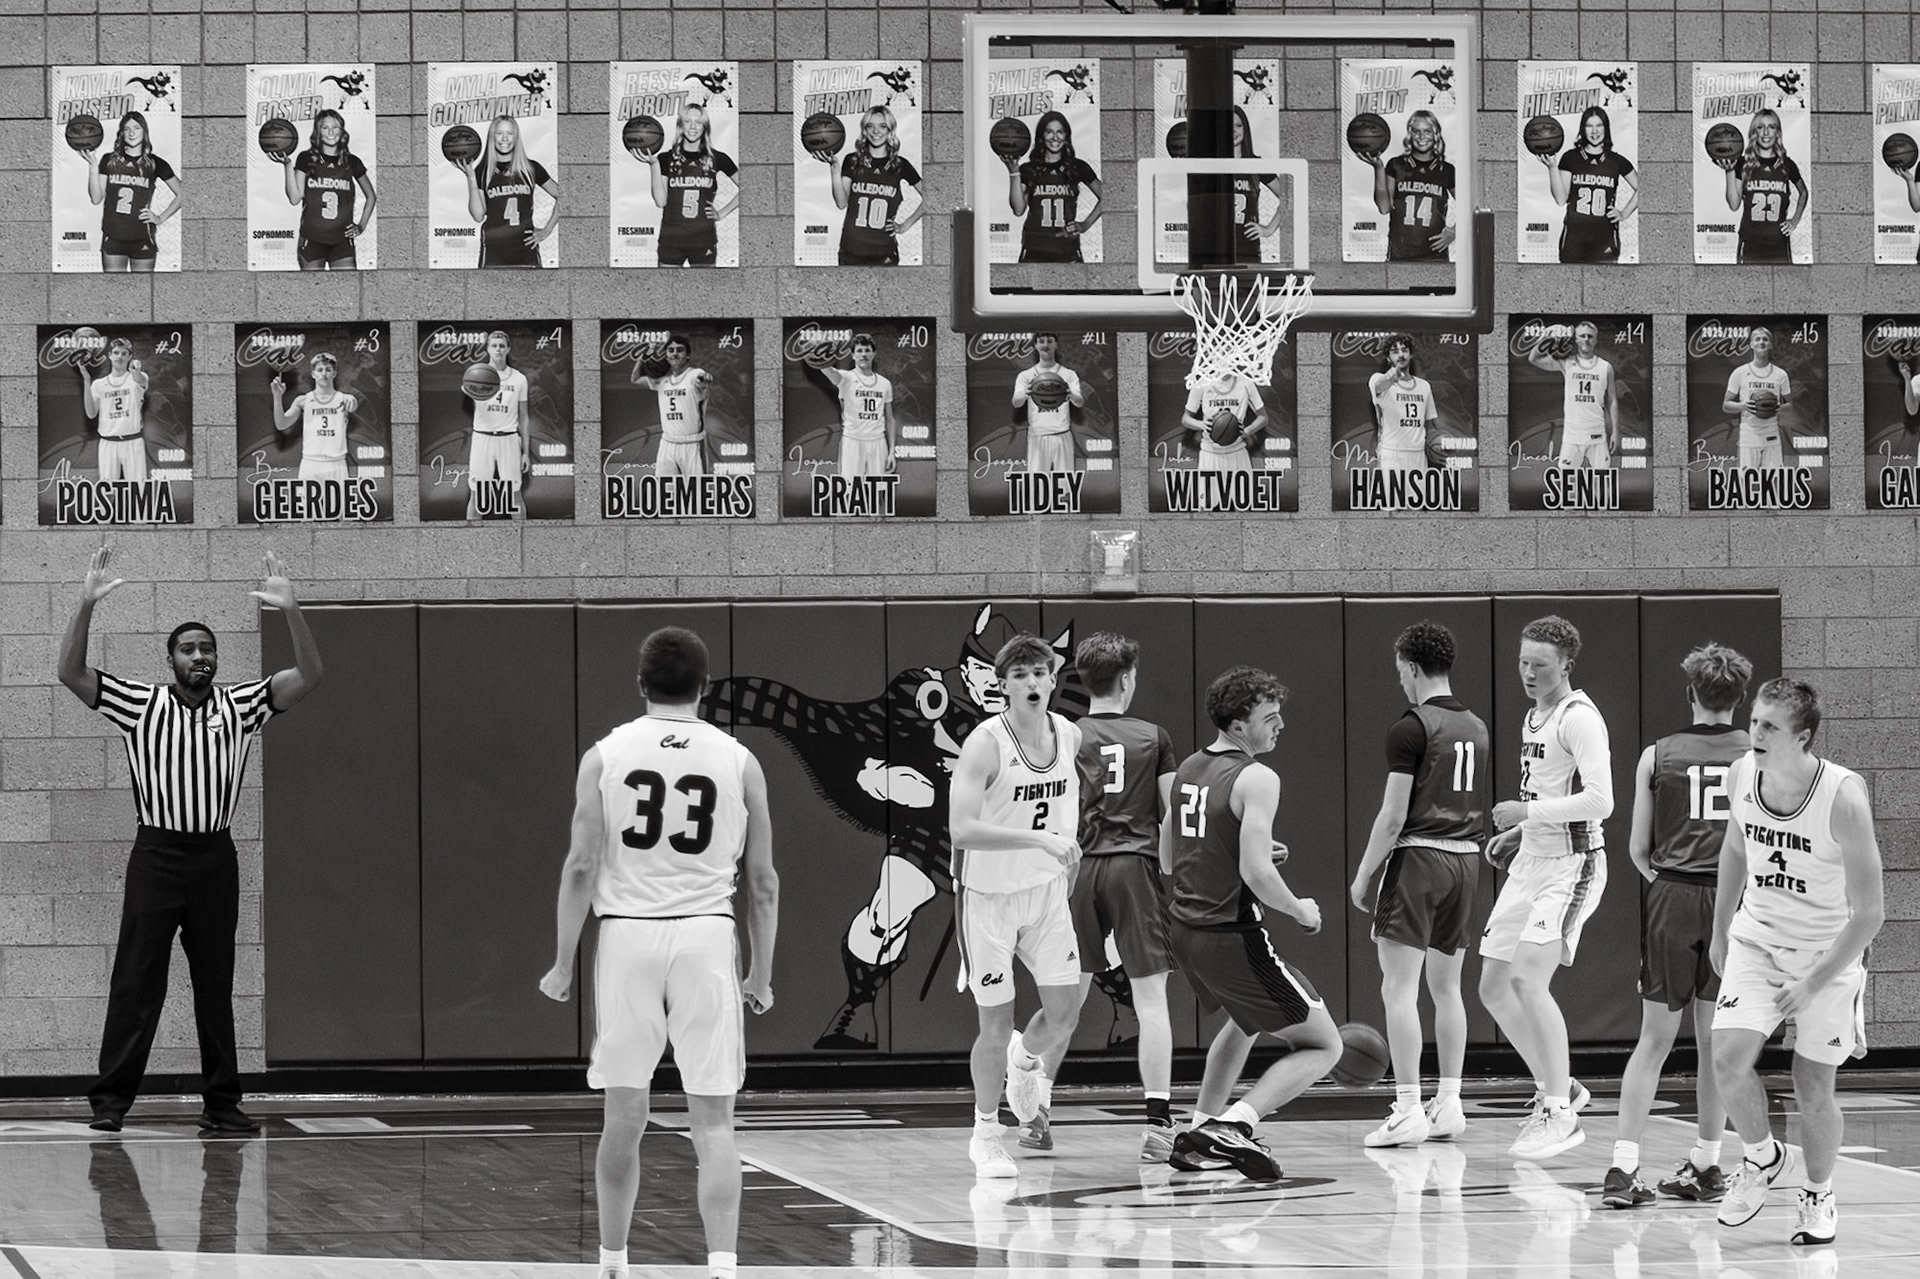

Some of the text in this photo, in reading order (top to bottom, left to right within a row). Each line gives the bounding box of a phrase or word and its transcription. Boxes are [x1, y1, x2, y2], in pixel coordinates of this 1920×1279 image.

[65, 71, 122, 99] KAYLA
[259, 72, 316, 100] OLIVIA
[445, 73, 497, 100] MYLA
[625, 67, 681, 95] REESE
[809, 65, 863, 93] MAYA
[1360, 65, 1402, 92] ADDI
[1533, 66, 1577, 92] LEAH
[57, 94, 135, 125] BRISENO
[256, 95, 323, 126] FOSTER
[430, 93, 541, 127] GORTMAKER
[618, 90, 689, 121] ABBOTT
[804, 88, 872, 119] TERRYN
[988, 90, 1054, 120] EVRIES
[1356, 88, 1409, 115] VELDT
[1523, 87, 1600, 118] HILEMAN
[1702, 92, 1766, 120] MCLEOD
[116, 187, 134, 214] 2
[322, 191, 338, 219] 3
[503, 197, 520, 227] 4
[682, 189, 700, 219] 5
[855, 196, 889, 230] 10
[1041, 198, 1065, 228] 11
[1234, 193, 1247, 224] 2
[1403, 195, 1433, 227] 14
[1576, 187, 1606, 217] 20
[1751, 193, 1781, 222] 23
[62, 231, 87, 240] JUNIOR
[252, 230, 295, 239] SOPHOMORE
[434, 228, 476, 237] SOPHOMORE
[618, 227, 655, 236] FRESHMAN
[804, 225, 829, 234] JUNIOR
[1353, 222, 1377, 231] JUNIOR
[1526, 223, 1549, 231] JUNIOR
[1697, 224, 1736, 232] SOPHOMORE
[1877, 225, 1916, 233] SOPHOMORE
[155, 331, 183, 355] #2
[354, 328, 381, 353] #3
[536, 327, 563, 350] #4
[718, 326, 743, 349] #5
[897, 325, 929, 348] #10
[1149, 332, 1197, 358] Ca
[1332, 332, 1383, 357] Ca
[1614, 322, 1645, 344] #14
[1791, 321, 1819, 344] #15
[496, 392, 503, 404] 4
[1579, 381, 1592, 394] 14
[115, 398, 123, 411] 2
[670, 398, 676, 411] 5
[864, 398, 876, 412] 10
[1405, 403, 1418, 418] 13
[322, 416, 328, 428] 3
[1441, 437, 1477, 450] FORWARD
[56, 479, 177, 524] POSTMA
[254, 477, 378, 522] GEERDES
[474, 478, 521, 515] UYL
[606, 474, 753, 518] BLOEMERS
[812, 473, 900, 516] PRATT
[1004, 470, 1085, 514] TIDEY
[1164, 468, 1285, 512] WITVOET
[1350, 467, 1461, 510] HANSON
[1542, 466, 1620, 510] SENTI
[1708, 466, 1812, 509] BACKUS
[660, 735, 690, 749] Cal
[1100, 743, 1126, 794] 3
[1453, 741, 1475, 792] 11
[1013, 778, 1068, 802] FIGHTING
[1686, 765, 1731, 821] 12
[621, 769, 718, 855] 33
[1032, 801, 1049, 830] 2
[1180, 782, 1210, 838] 21
[1745, 822, 1812, 854] FIGHTING
[1768, 850, 1787, 872] 4
[1755, 873, 1807, 894] SCOTS
[981, 972, 1005, 987] Cal
[1717, 995, 1739, 1011] Cal
